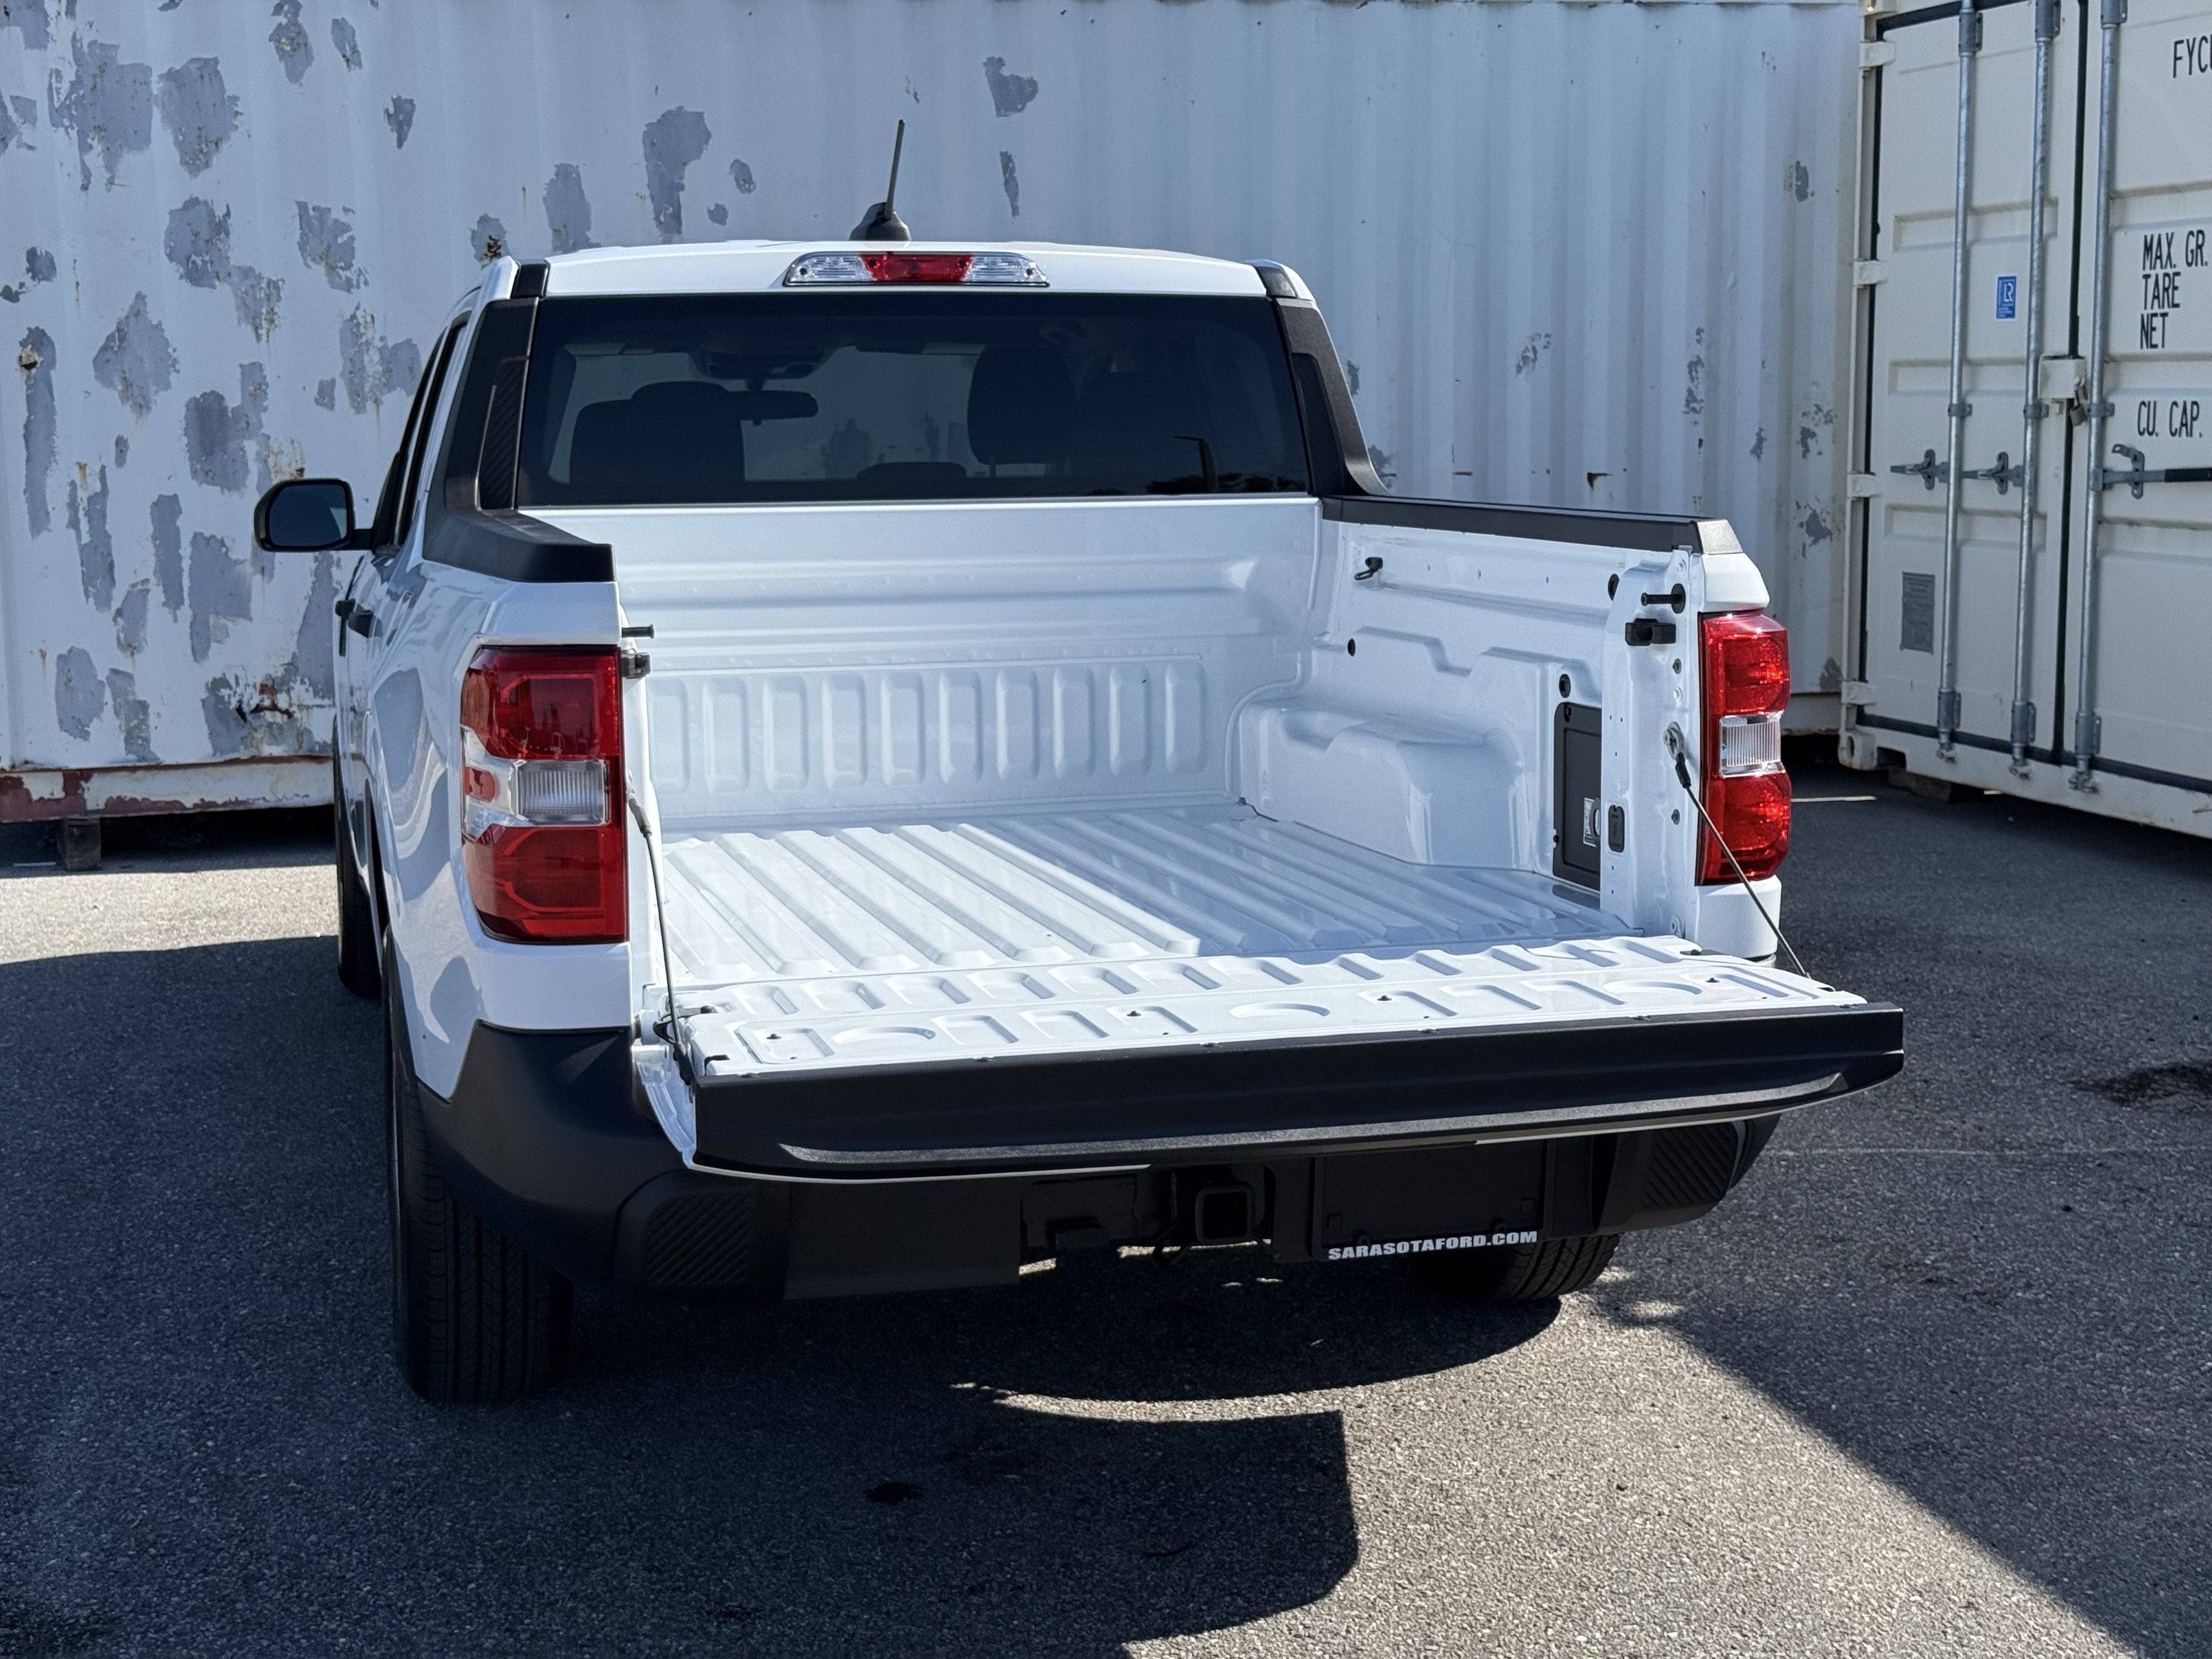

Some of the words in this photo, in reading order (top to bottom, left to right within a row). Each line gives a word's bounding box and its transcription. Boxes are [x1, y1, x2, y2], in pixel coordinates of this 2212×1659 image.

[2172, 34, 2212, 78] FYC
[2142, 232, 2176, 271] MAX.
[2186, 229, 2208, 268] GR.
[2142, 272, 2181, 310] TARE
[2140, 312, 2169, 349] NET
[2137, 400, 2158, 437] CU.
[2169, 400, 2202, 438] CAP.
[1328, 1231, 1538, 1260] SARASOTAFORD.COM
